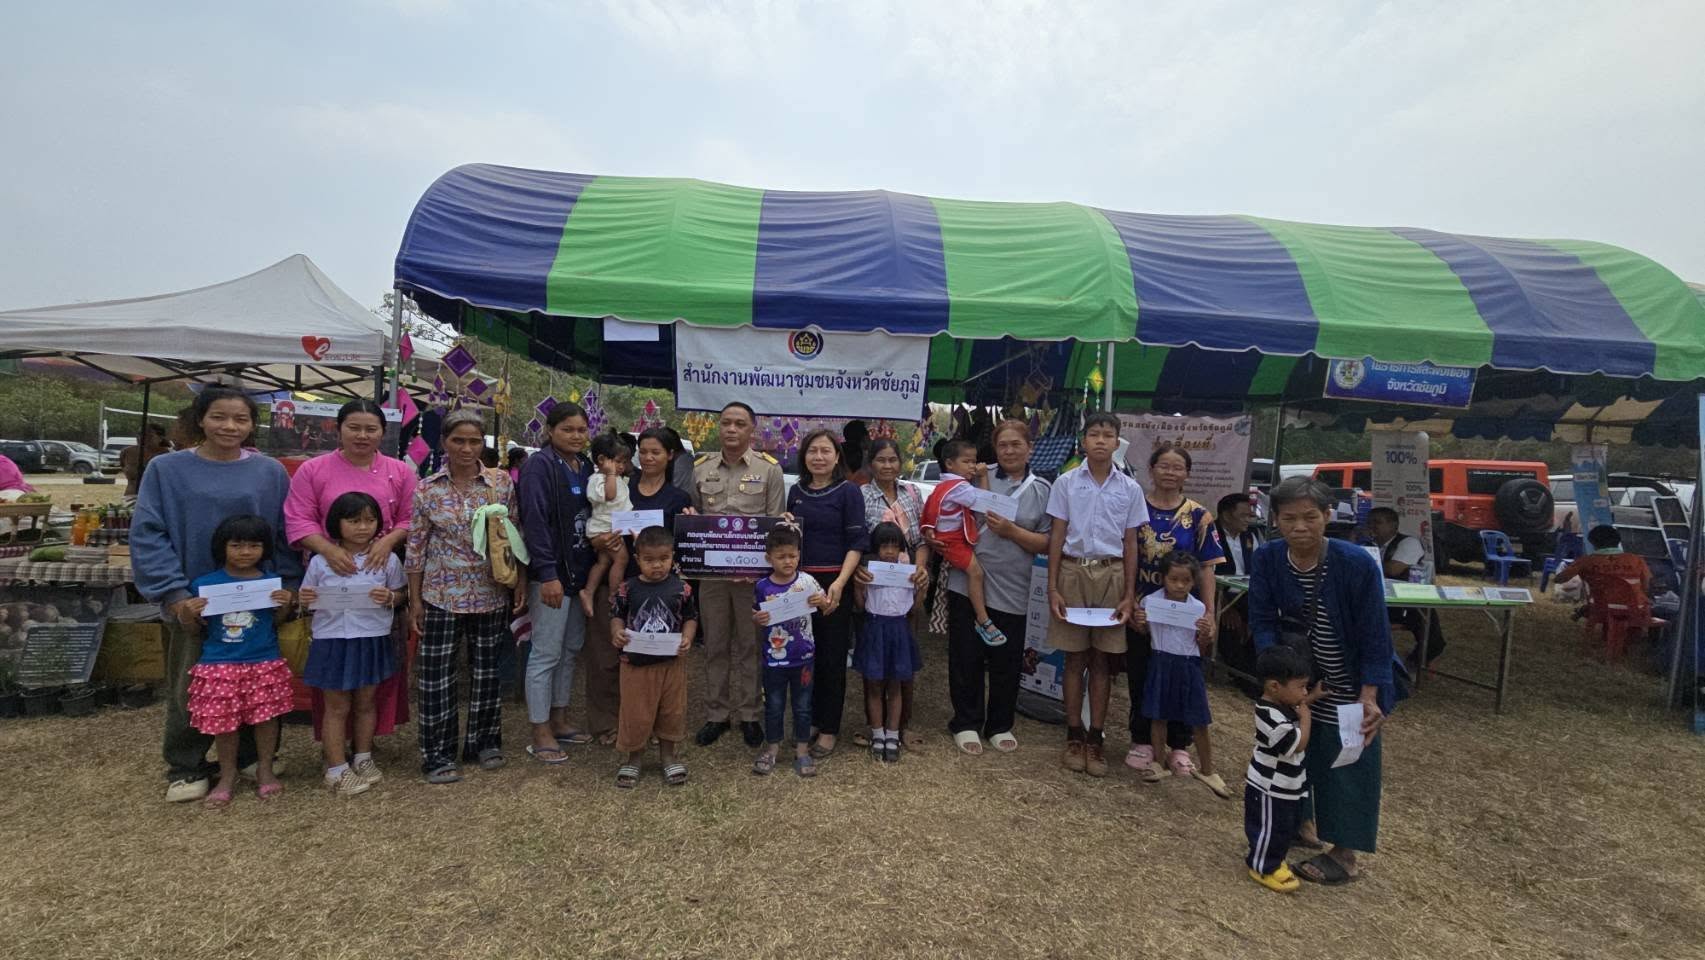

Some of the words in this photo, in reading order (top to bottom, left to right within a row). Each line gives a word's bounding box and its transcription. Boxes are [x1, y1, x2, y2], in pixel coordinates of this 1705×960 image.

[683, 363, 920, 399] สำนักงานพัฒนาชุมชนจังหวัดชัยภูมิ
[1386, 378, 1447, 397] จังหวัดชัยภูมิ
[1385, 451, 1418, 465] 100%
[681, 555, 702, 563] จำนวน
